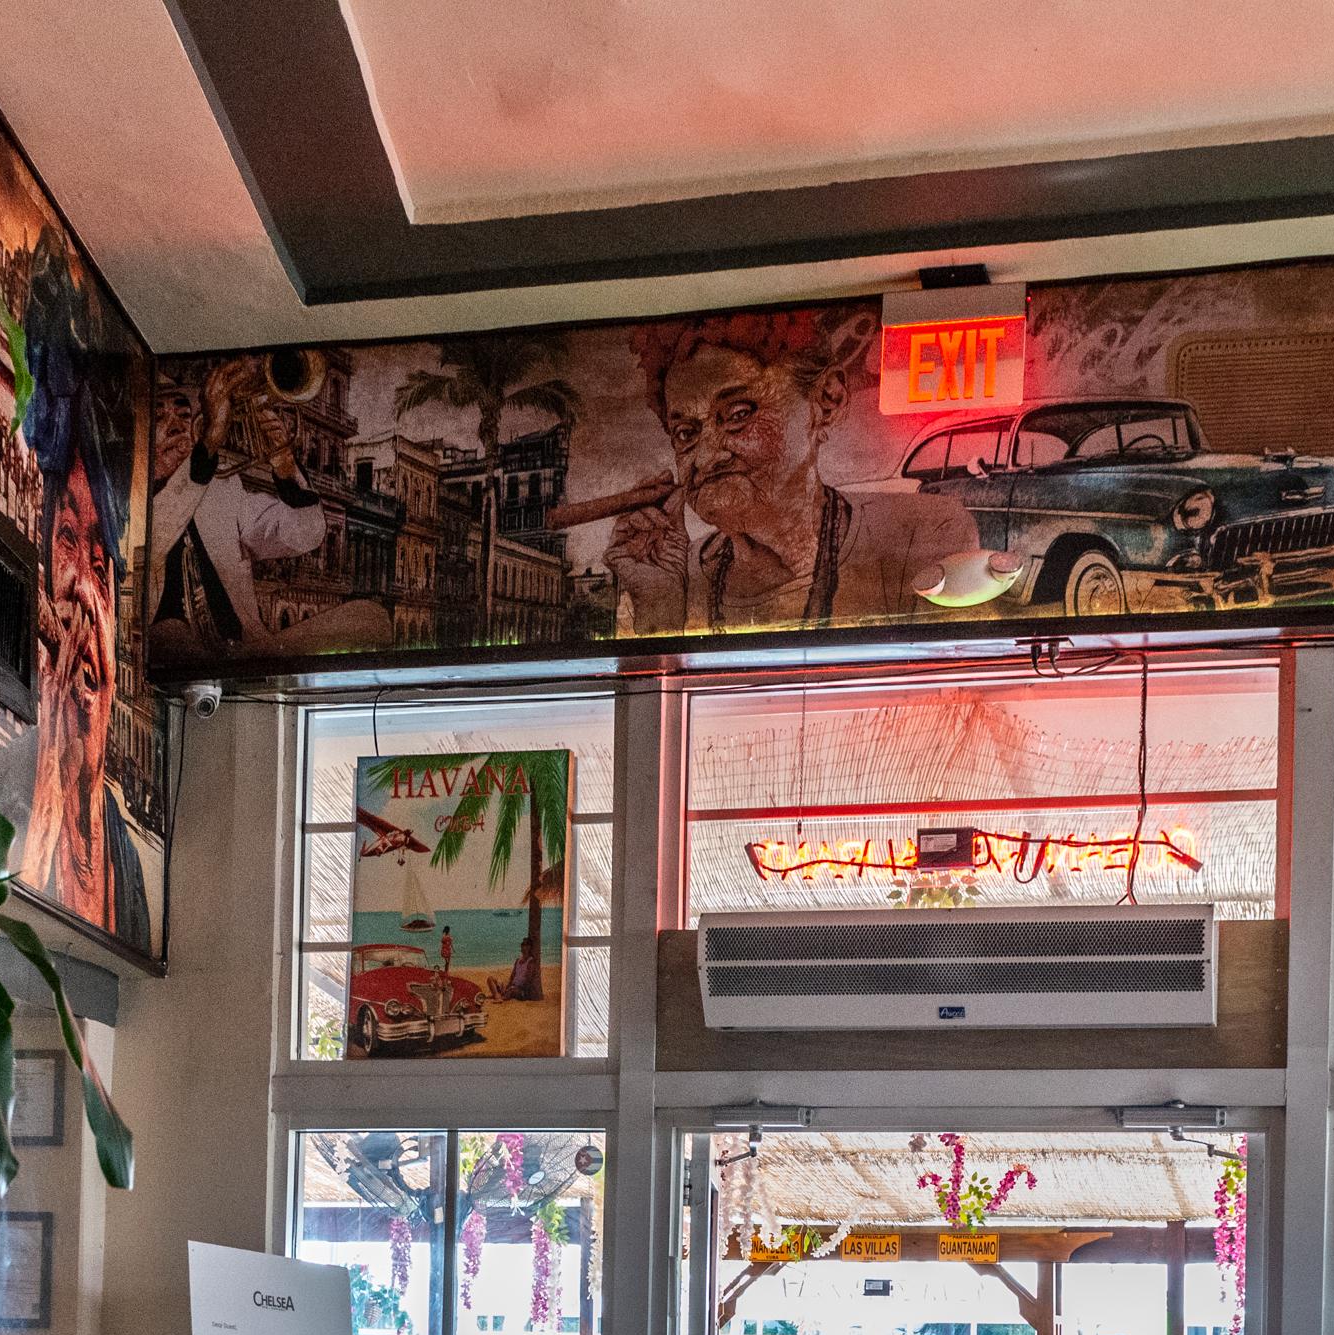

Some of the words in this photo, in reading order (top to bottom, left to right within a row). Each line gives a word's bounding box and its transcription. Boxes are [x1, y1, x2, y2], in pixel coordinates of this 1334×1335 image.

[908, 327, 1005, 403] EXIT
[391, 764, 531, 799] HAVANA
[434, 814, 485, 833] CUBA
[844, 1241, 862, 1255] LAS
[865, 1241, 898, 1256] VILLAS
[940, 1241, 996, 1255] GUANTANAMO
[253, 1290, 295, 1311] CHELSEA
